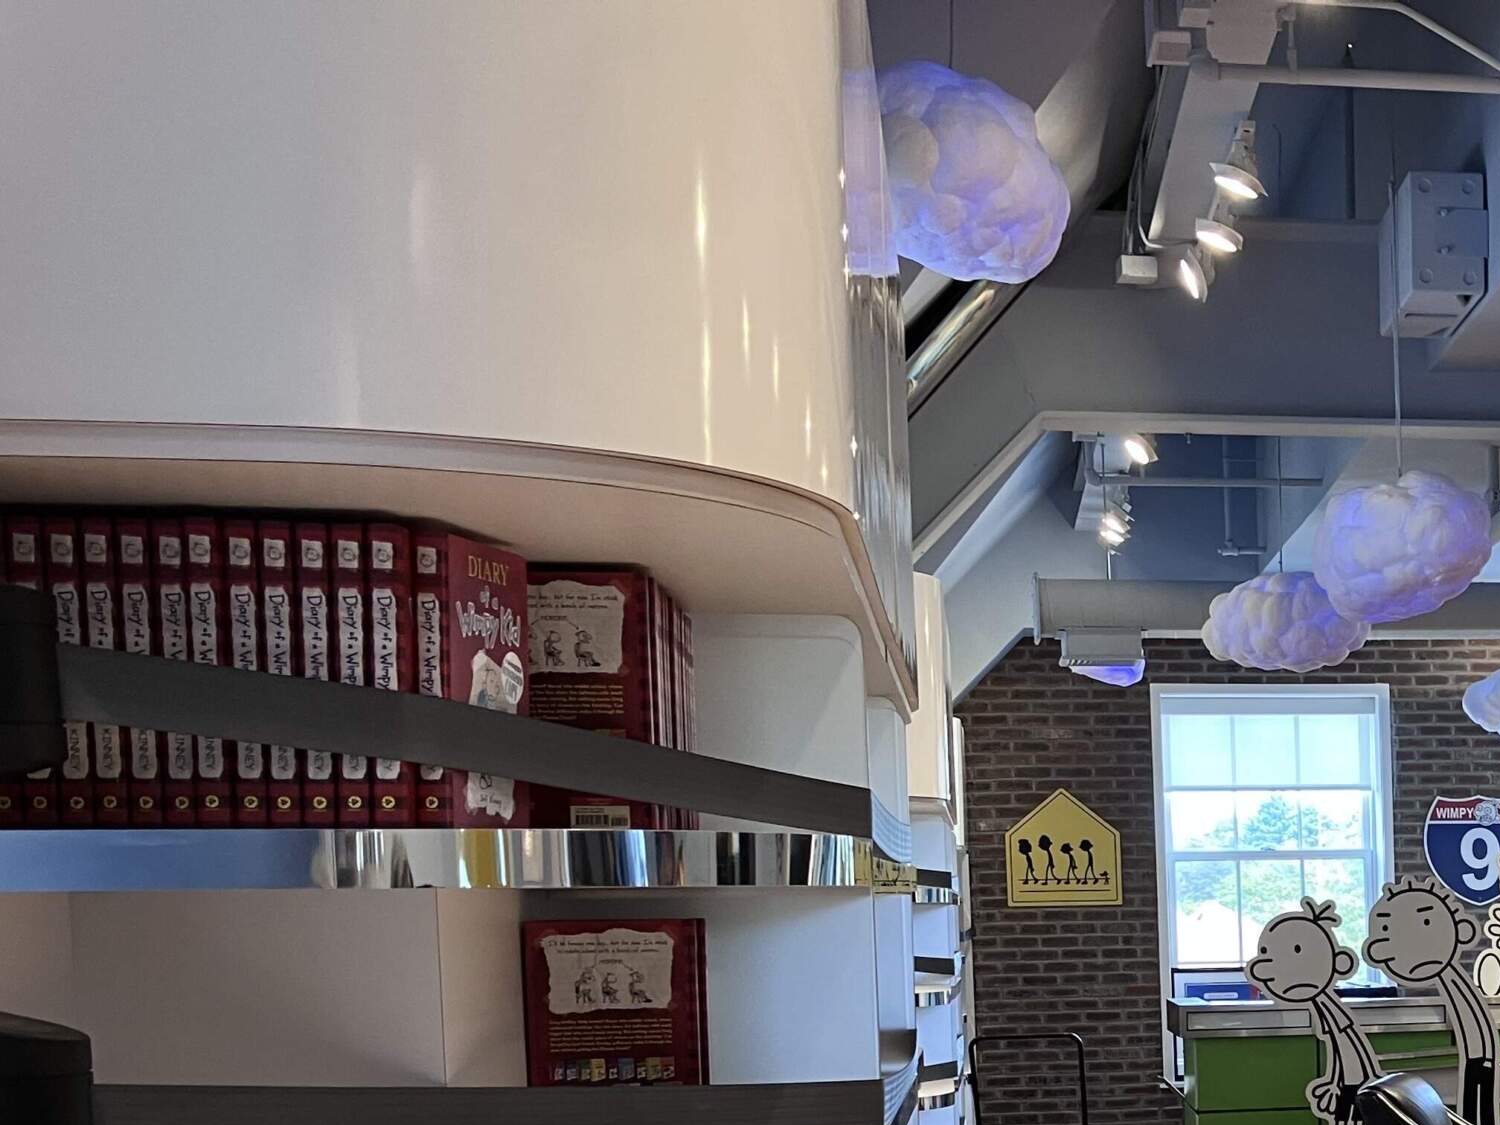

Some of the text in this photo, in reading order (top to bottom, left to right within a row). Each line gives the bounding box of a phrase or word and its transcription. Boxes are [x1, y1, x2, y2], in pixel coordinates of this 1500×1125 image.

[468, 555, 508, 586] DIARY
[455, 601, 520, 649] Wimpy Kid
[344, 651, 360, 684] Wimp
[175, 736, 187, 771] INNEY
[1436, 807, 1474, 819] WIMPY
[1460, 827, 1500, 891] 9
